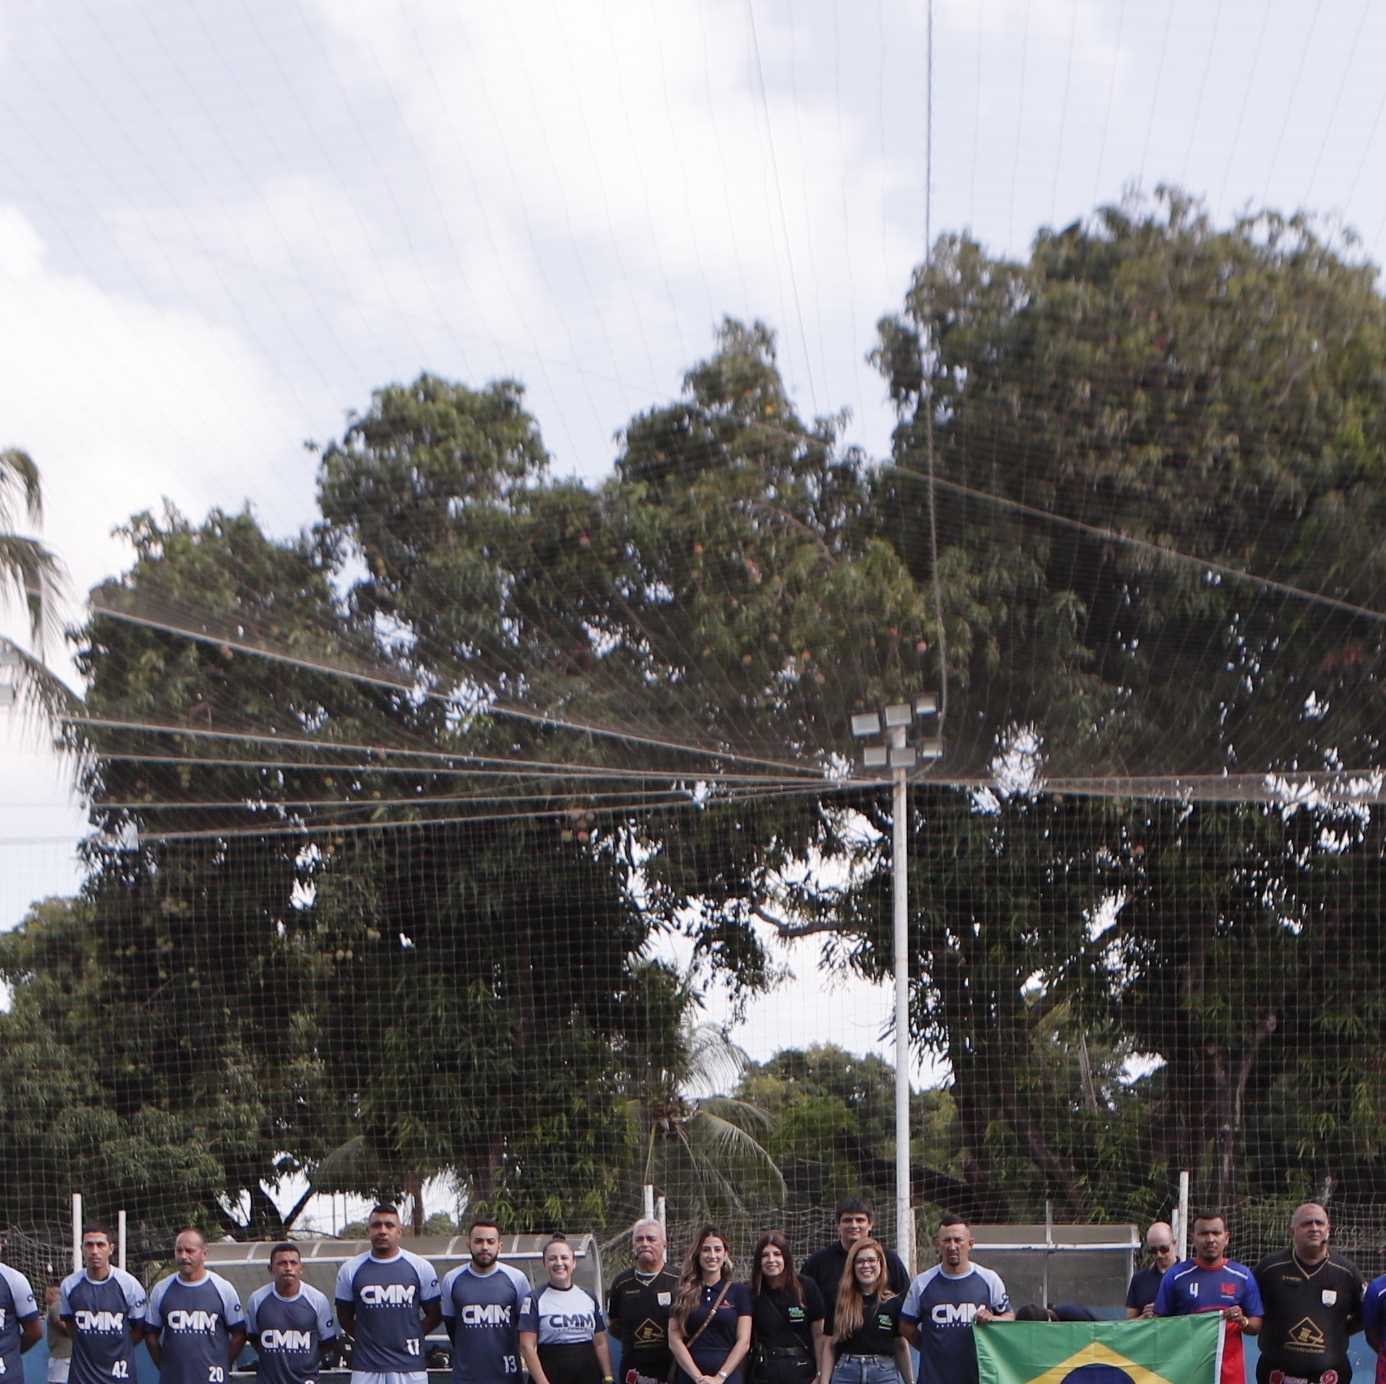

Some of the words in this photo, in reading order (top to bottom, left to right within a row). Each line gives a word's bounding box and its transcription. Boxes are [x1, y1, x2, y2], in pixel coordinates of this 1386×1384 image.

[360, 1284, 416, 1304] CMM
[1190, 1282, 1199, 1298] 4
[74, 1310, 124, 1331] CMM
[168, 1310, 218, 1331] CMM
[462, 1305, 511, 1324] CMM
[549, 1314, 594, 1328] CMM
[261, 1329, 311, 1349] CMM
[112, 1361, 129, 1379] 42
[503, 1356, 517, 1373] 13
[209, 1366, 224, 1383] 20
